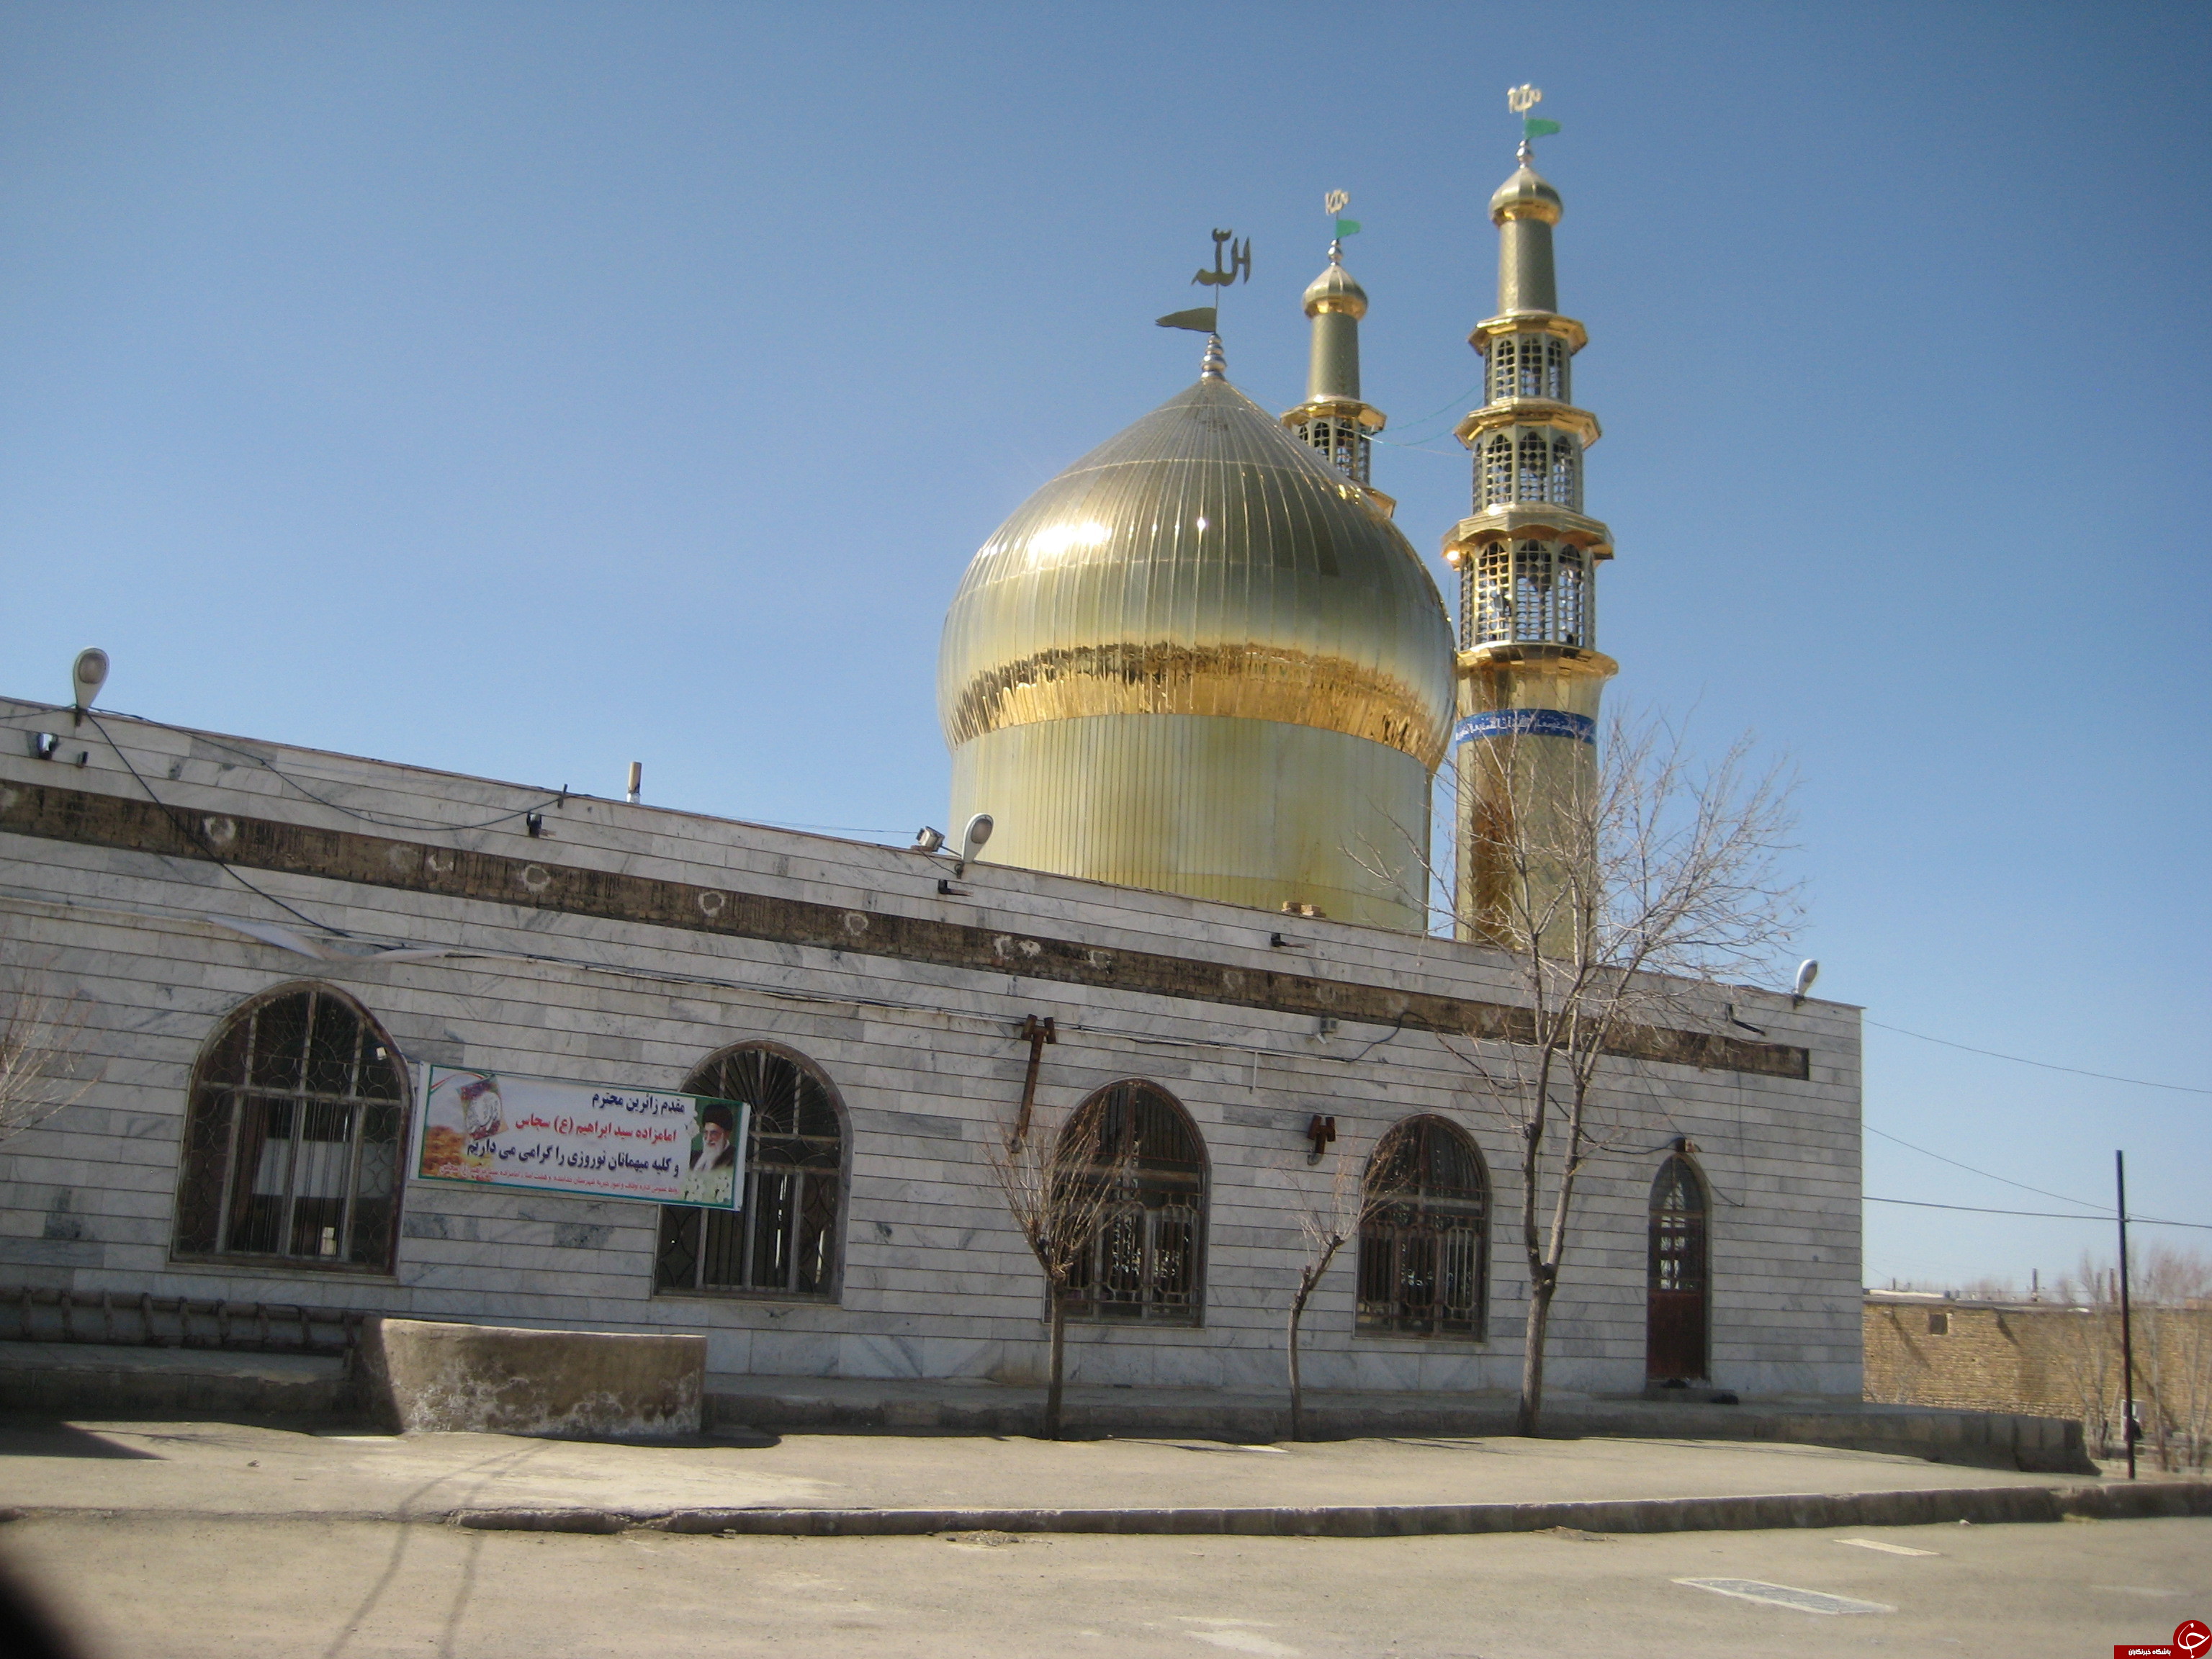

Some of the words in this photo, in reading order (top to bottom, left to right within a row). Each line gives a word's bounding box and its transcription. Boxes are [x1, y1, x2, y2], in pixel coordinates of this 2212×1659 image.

[592, 1092, 624, 1109] محترم
[626, 1092, 659, 1115] زائرین
[660, 1098, 685, 1115] مقدم
[516, 1112, 551, 1132] سجاس
[554, 1115, 574, 1135] (ع)
[576, 1120, 612, 1138] ابراهیم
[614, 1125, 633, 1140] سید
[636, 1126, 677, 1144] امامزاده
[467, 1138, 496, 1158] داریم
[498, 1146, 516, 1160] می
[518, 1143, 553, 1164] گرامی
[556, 1146, 565, 1166] را
[567, 1150, 606, 1169] نوروزی
[608, 1151, 649, 1173] میهمانان
[651, 1156, 672, 1175] کلیه
[673, 1164, 679, 1177] و
